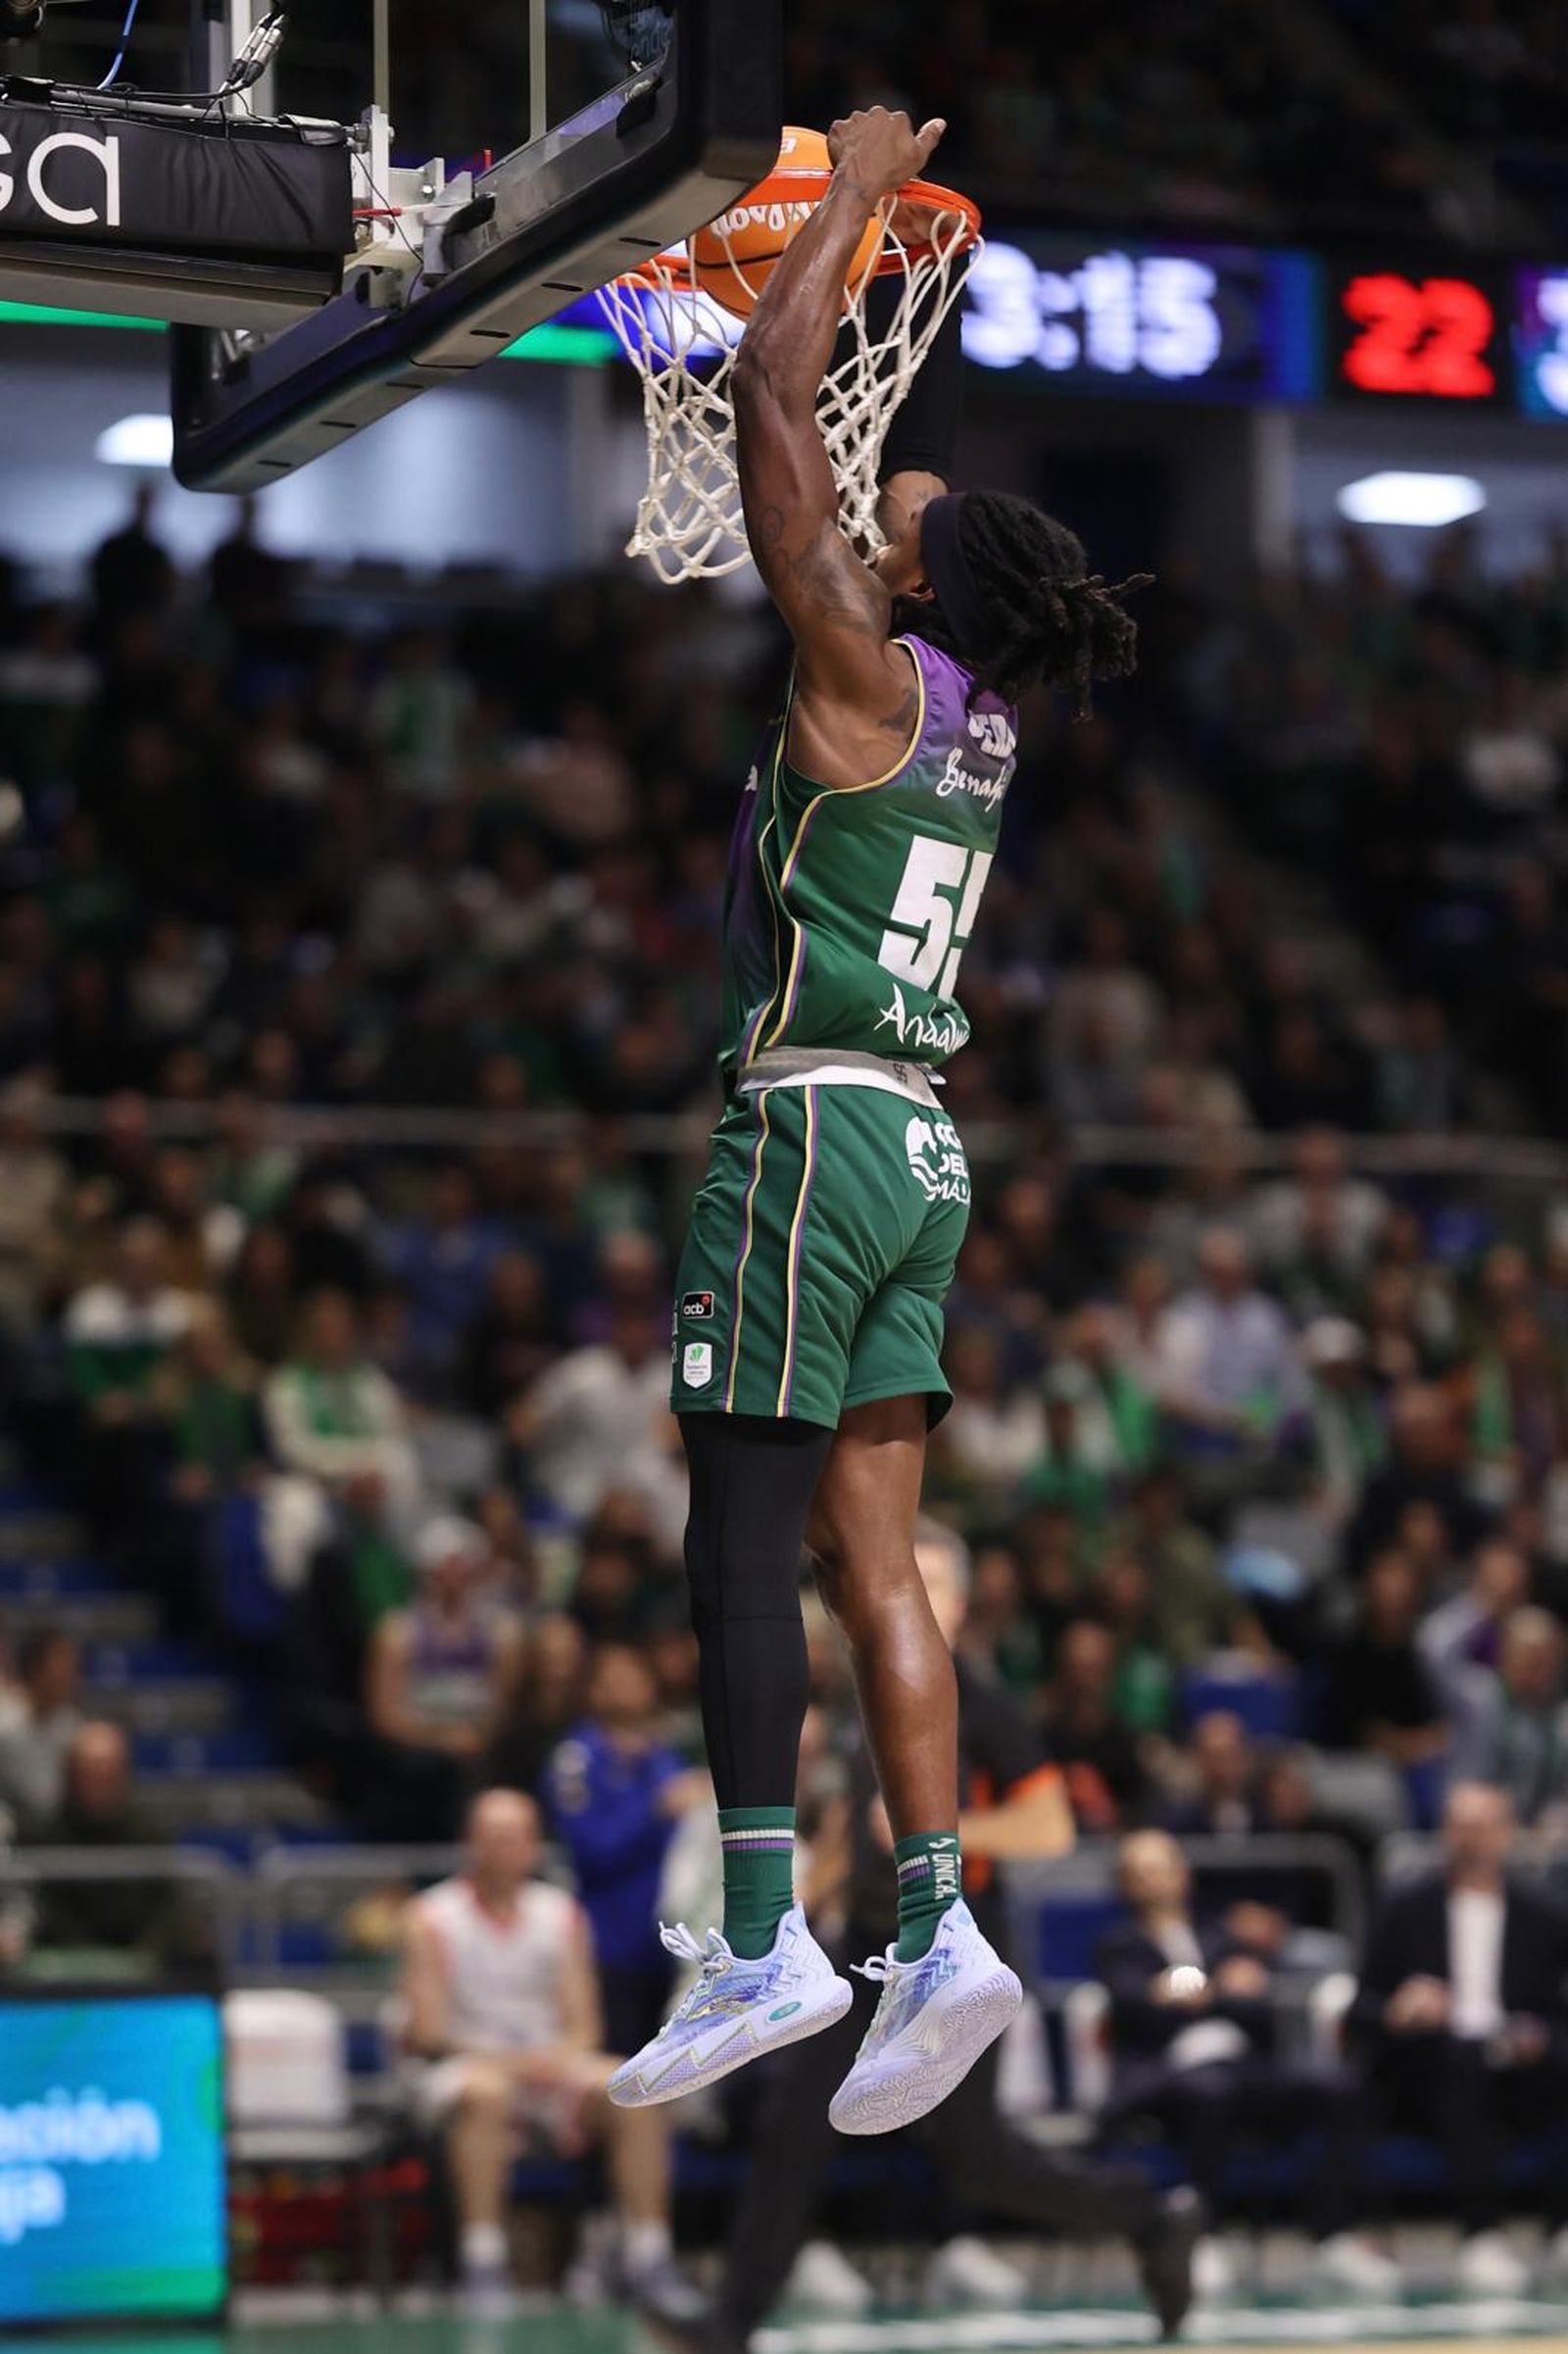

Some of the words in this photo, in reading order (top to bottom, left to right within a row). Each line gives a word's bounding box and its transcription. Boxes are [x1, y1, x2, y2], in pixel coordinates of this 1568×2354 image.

[0, 131, 120, 226] a
[960, 242, 1222, 380] 3:15
[1343, 272, 1495, 398] 22
[683, 1302, 705, 1316] acb
